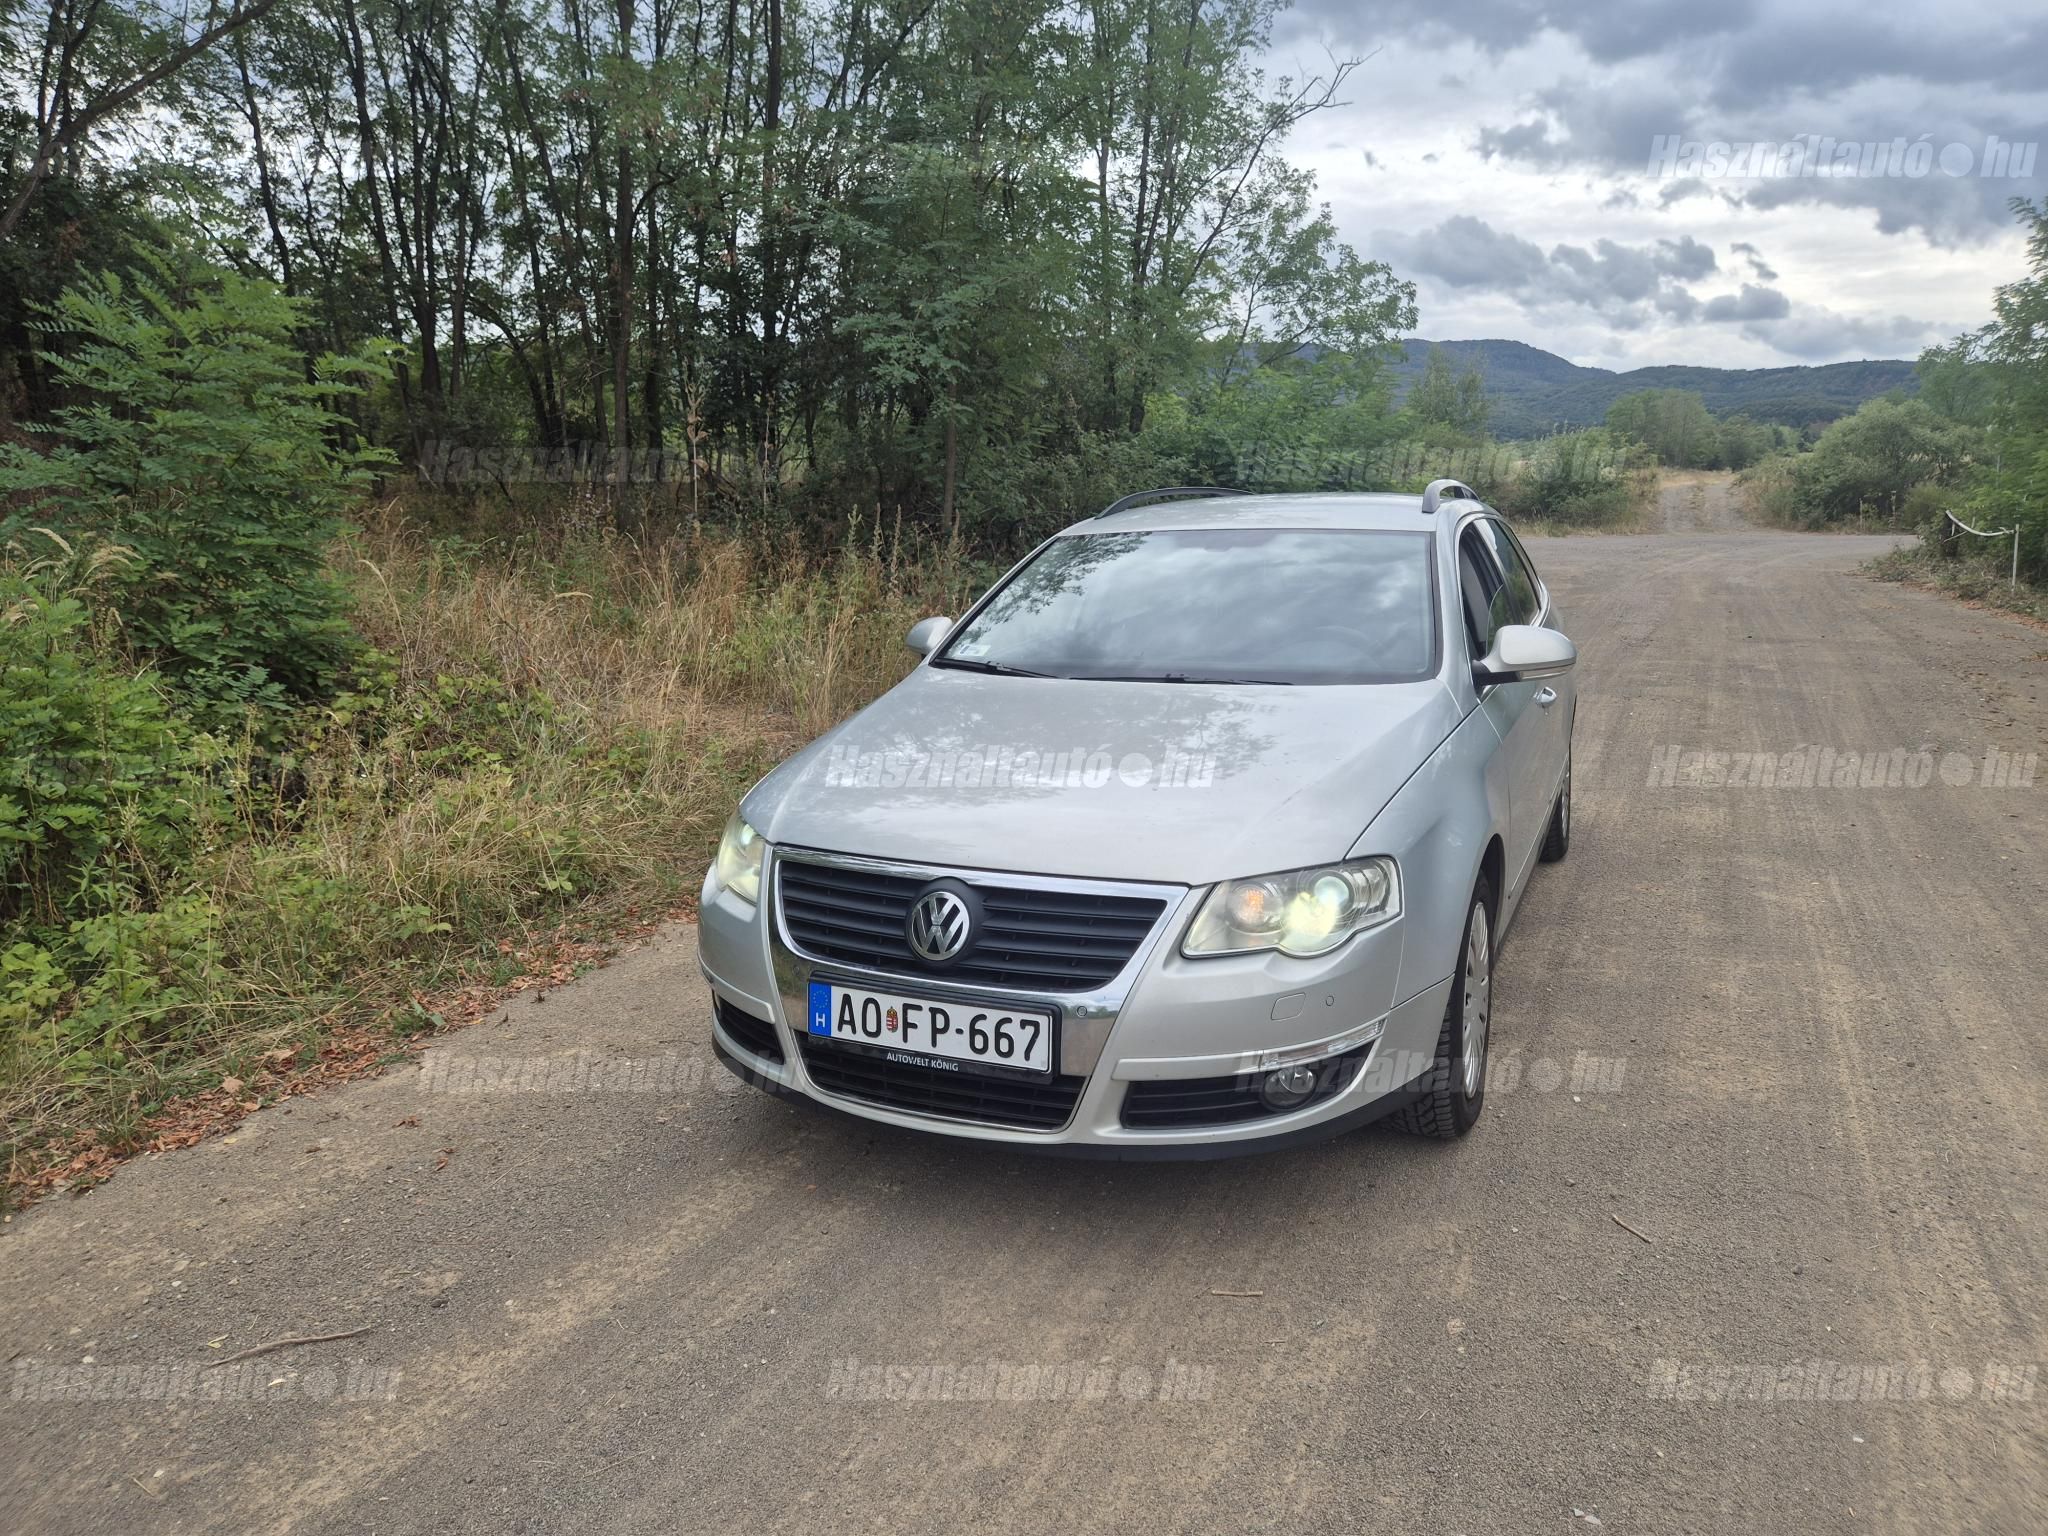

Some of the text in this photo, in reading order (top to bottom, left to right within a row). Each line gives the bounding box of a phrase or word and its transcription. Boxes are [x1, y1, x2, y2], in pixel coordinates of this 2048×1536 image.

[815, 1012, 826, 1029] H
[886, 1051, 959, 1072] AUTOWELT KÖNIG
